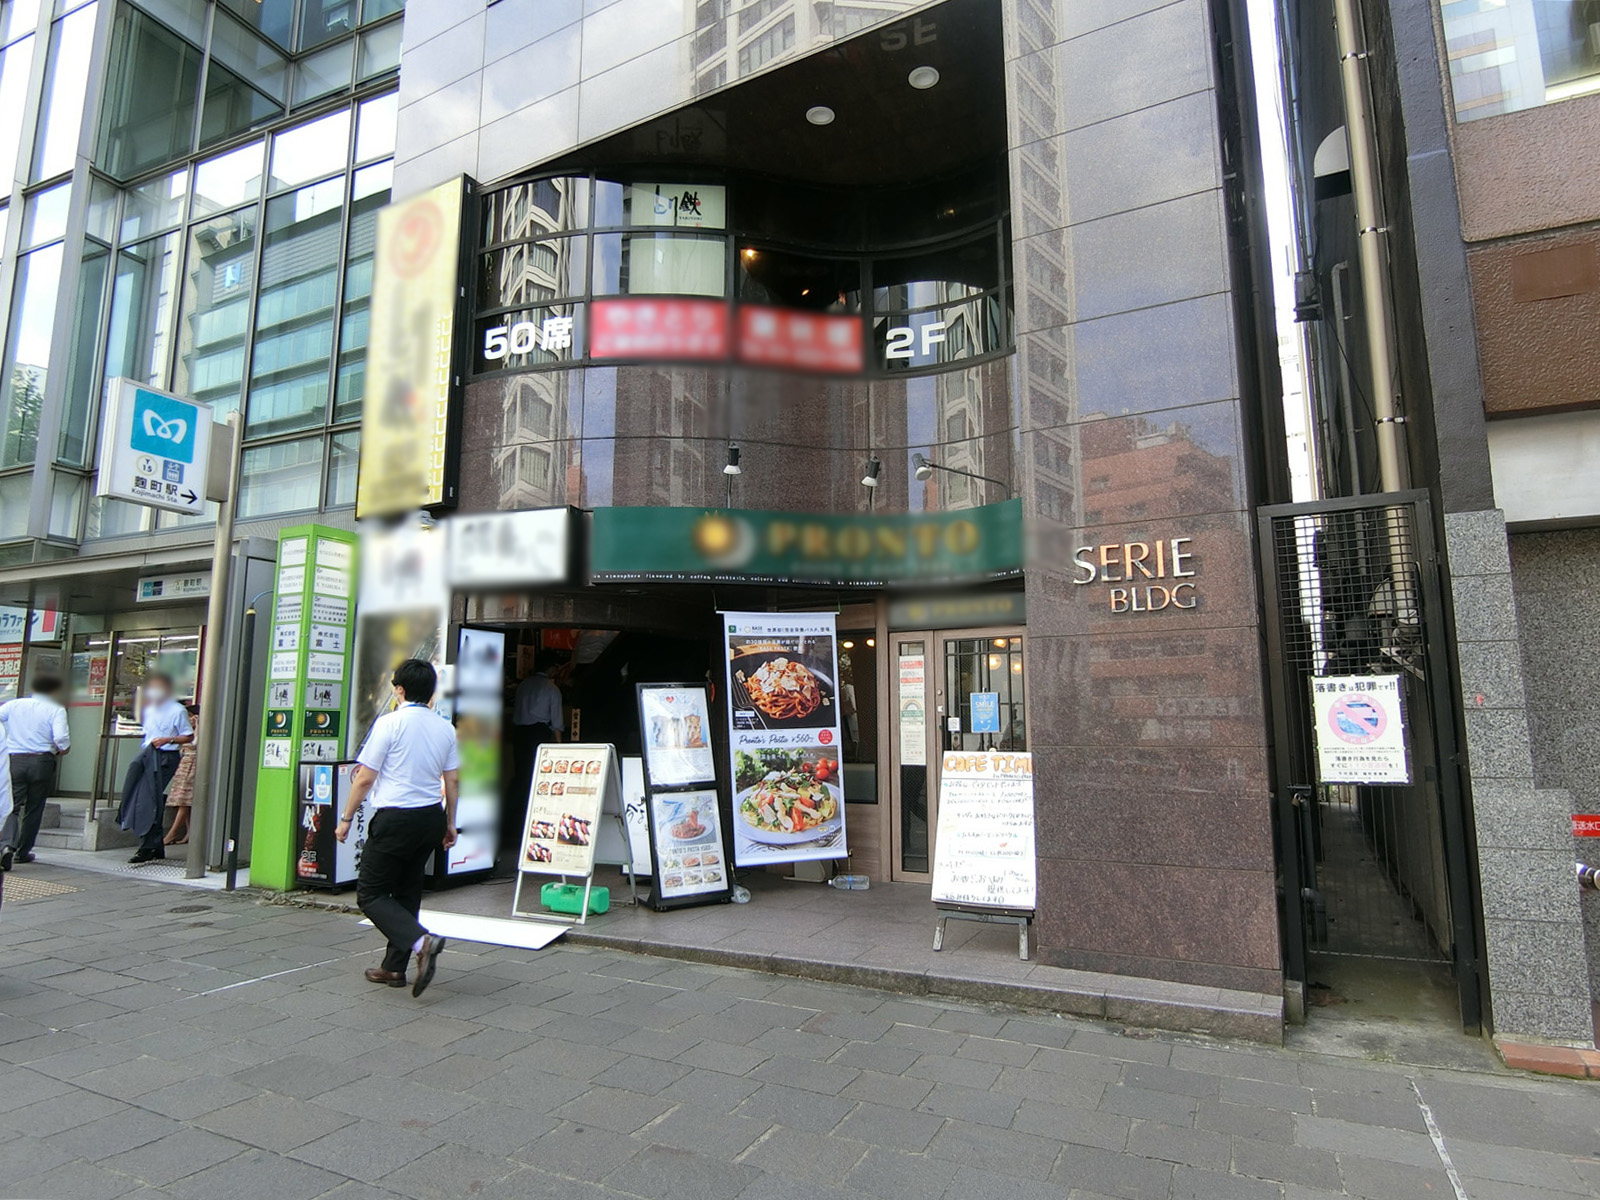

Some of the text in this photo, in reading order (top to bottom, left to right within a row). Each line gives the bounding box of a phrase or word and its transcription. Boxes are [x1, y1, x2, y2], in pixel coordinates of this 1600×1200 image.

[654, 184, 702, 227] とり鉄
[484, 316, 573, 360] 50席
[886, 321, 946, 359] 2F
[142, 464, 153, 473] 15
[131, 488, 165, 501] Kojimachi
[1073, 537, 1196, 585] SERIE
[1110, 583, 1196, 613] BLDG
[1314, 681, 1396, 693] 落書きは犯罪です!!
[944, 755, 987, 772] CAFE
[301, 850, 317, 862] 2F
